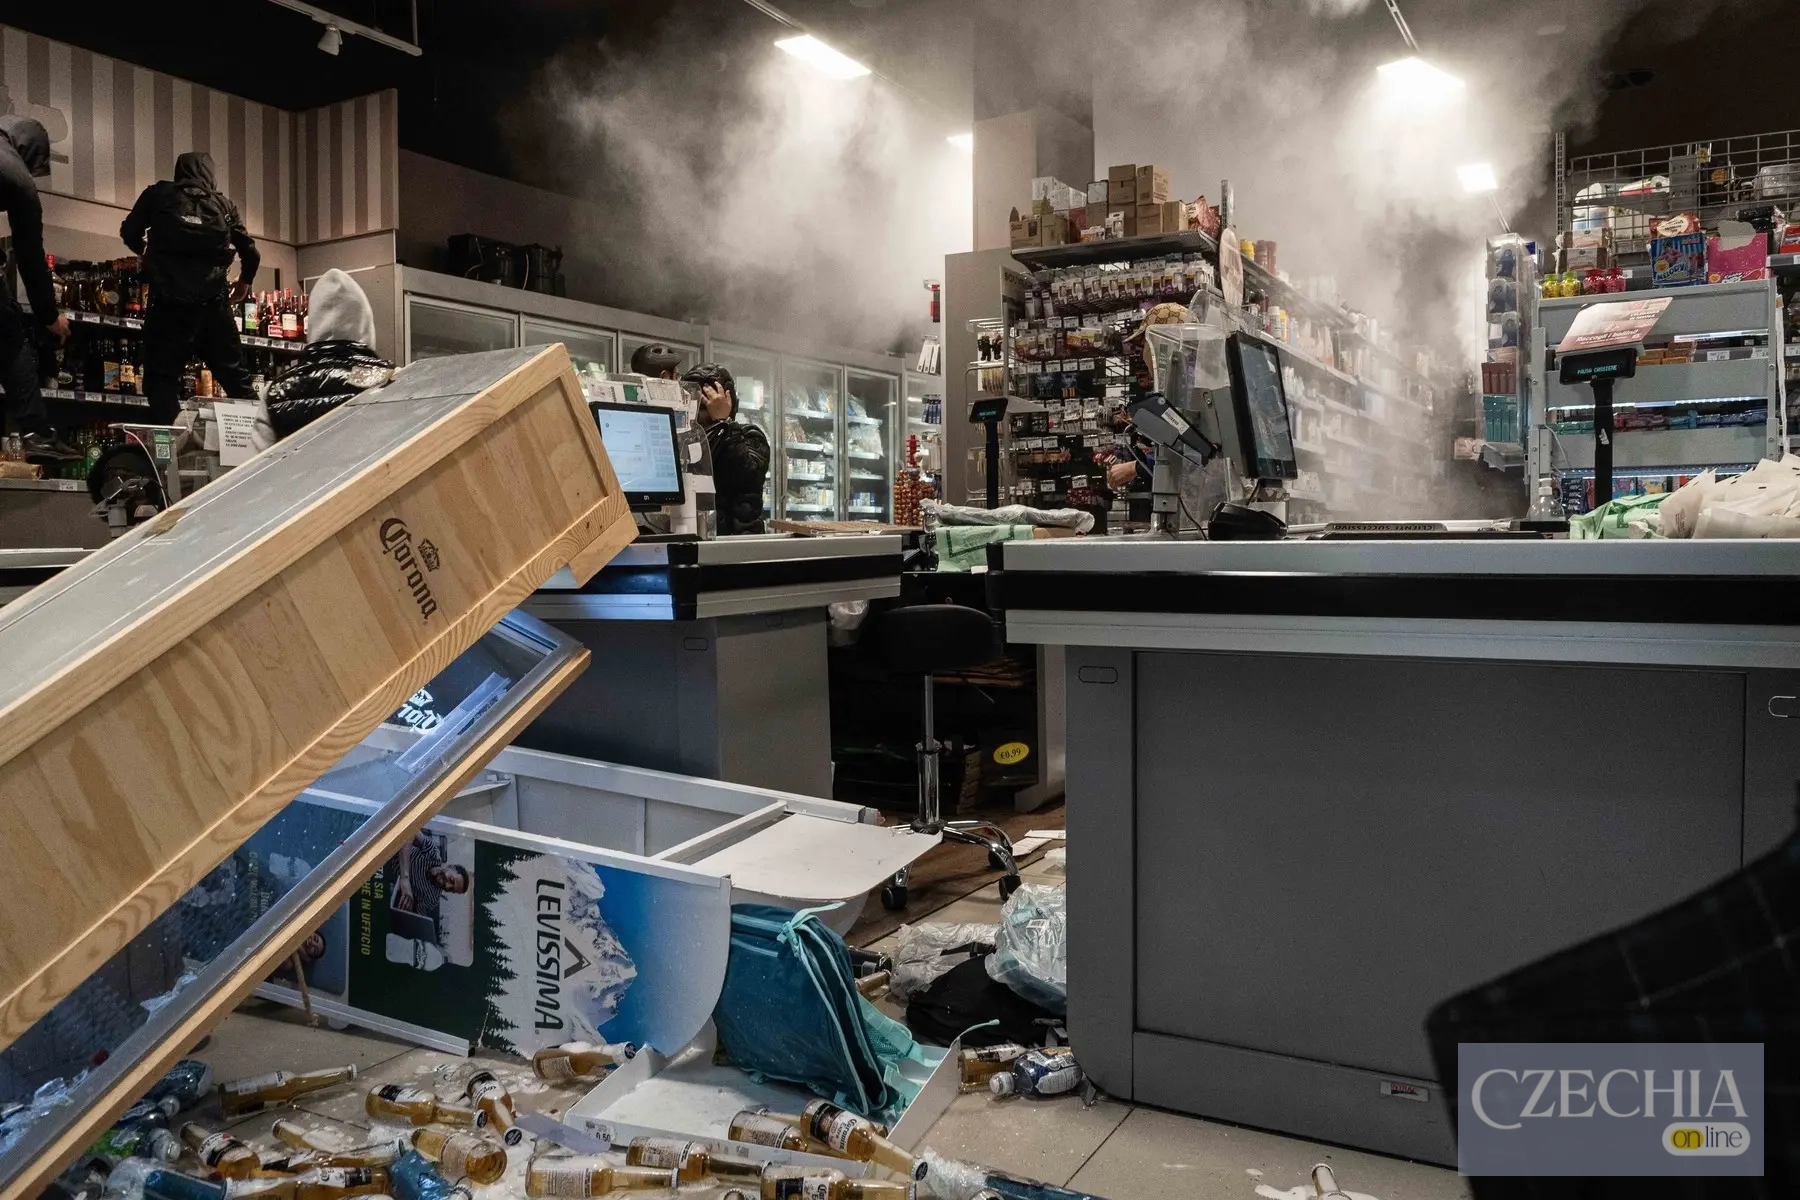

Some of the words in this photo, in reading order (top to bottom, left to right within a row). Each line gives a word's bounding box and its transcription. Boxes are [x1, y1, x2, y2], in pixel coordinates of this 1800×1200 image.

[380, 517, 437, 620] Corona
[361, 900, 371, 909] IN
[374, 881, 384, 899] SIA
[360, 914, 371, 956] UFFICIO
[535, 878, 565, 1030] LEVISSIMA
